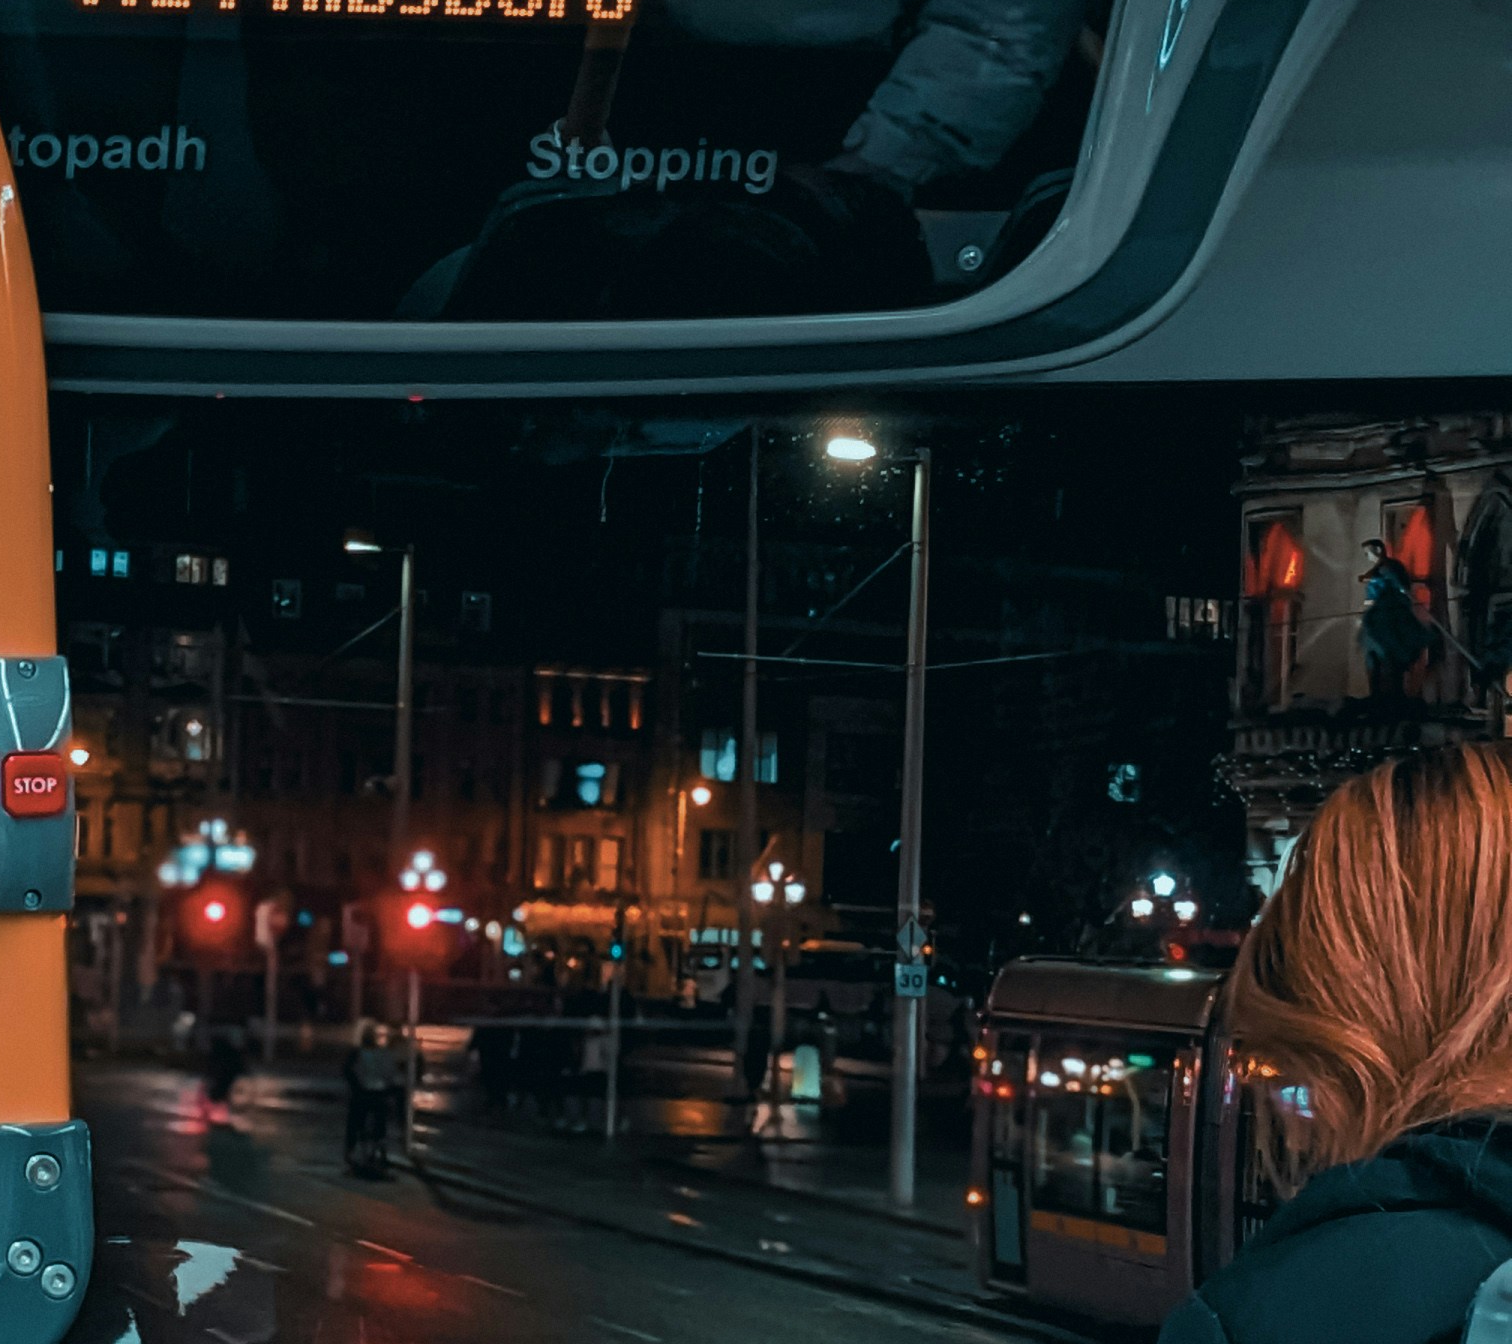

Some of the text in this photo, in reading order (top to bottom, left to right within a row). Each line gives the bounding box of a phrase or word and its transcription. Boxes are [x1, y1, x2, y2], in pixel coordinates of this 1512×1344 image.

[7, 123, 207, 180] topadh
[526, 120, 774, 198] Stopping
[13, 776, 58, 795] STOP
[899, 973, 924, 988] 30
